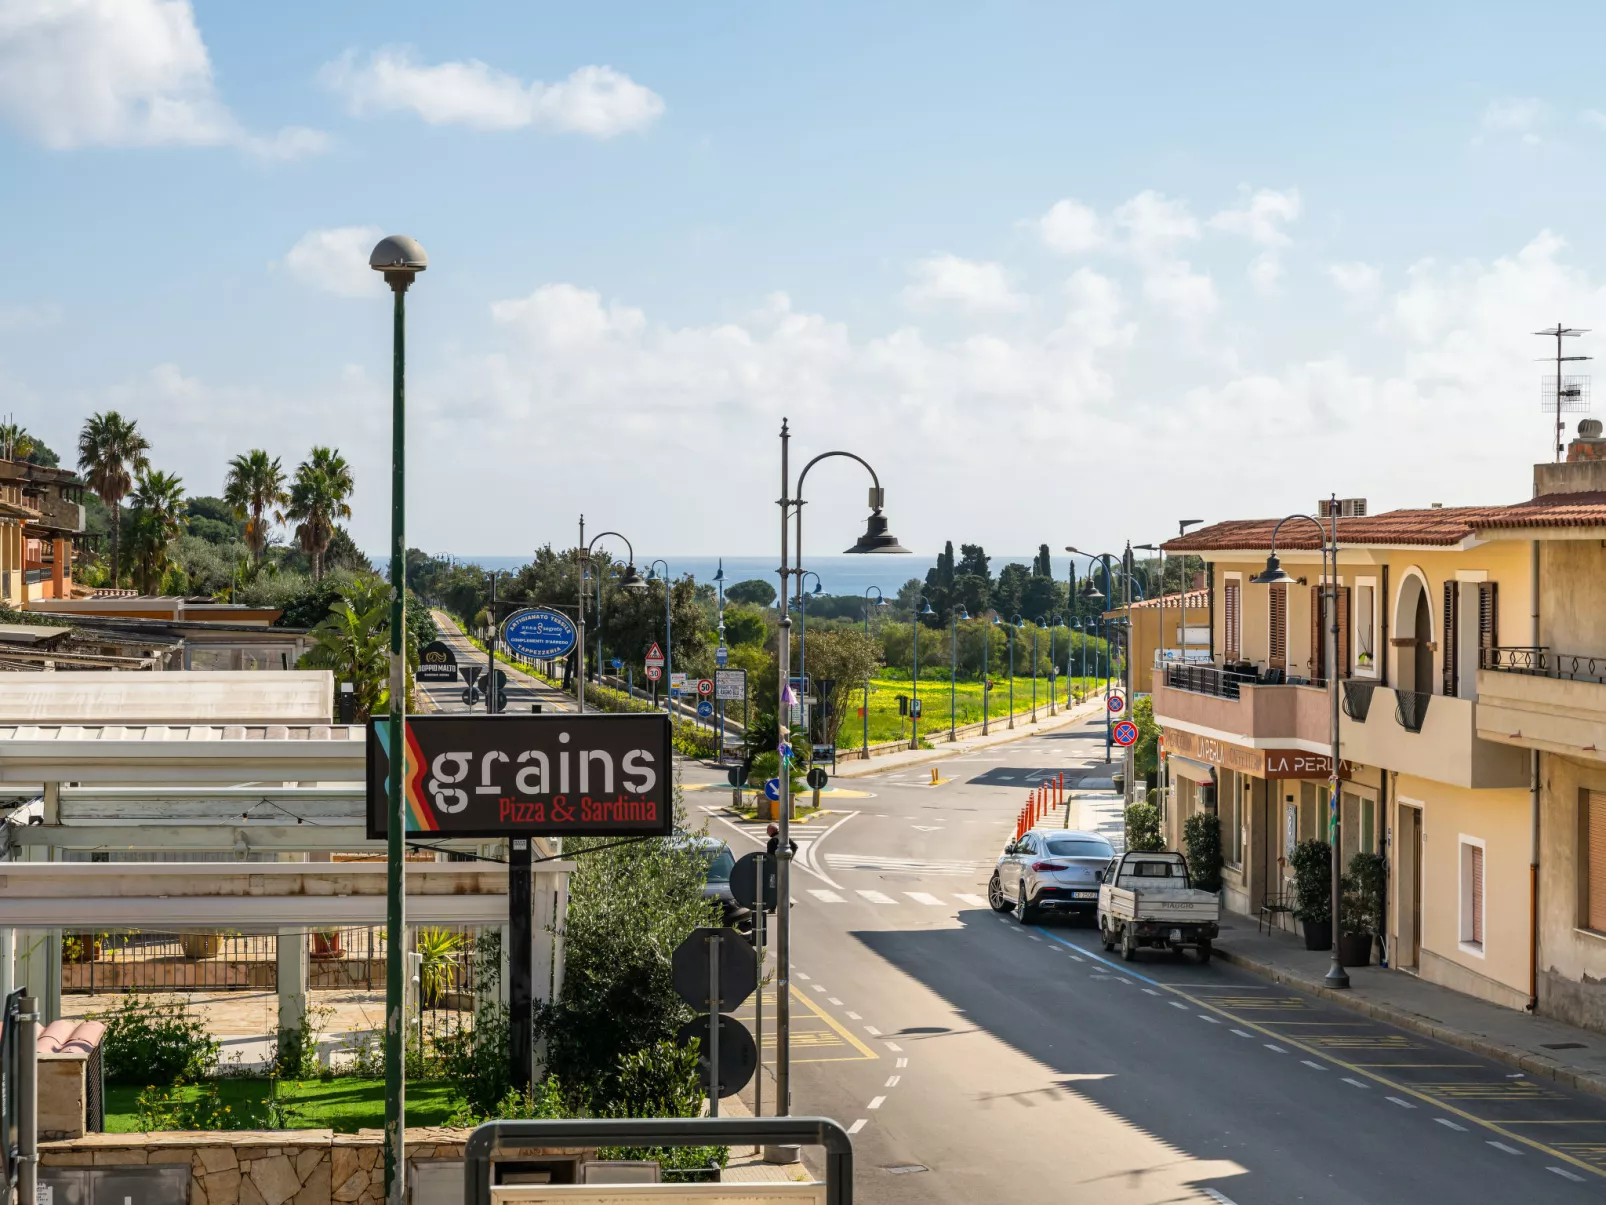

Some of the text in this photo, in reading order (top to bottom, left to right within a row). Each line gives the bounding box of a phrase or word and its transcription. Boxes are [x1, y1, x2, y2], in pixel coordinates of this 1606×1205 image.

[510, 614, 572, 634] ARTIGIANATO TESSILE
[517, 644, 562, 655] TAPPEZZERIA
[438, 664, 457, 672] MALTO
[701, 683, 710, 691] 50
[1267, 757, 1349, 772] LA PERLA
[428, 731, 657, 814] grains
[498, 795, 657, 823] Pizza & Sardinia
